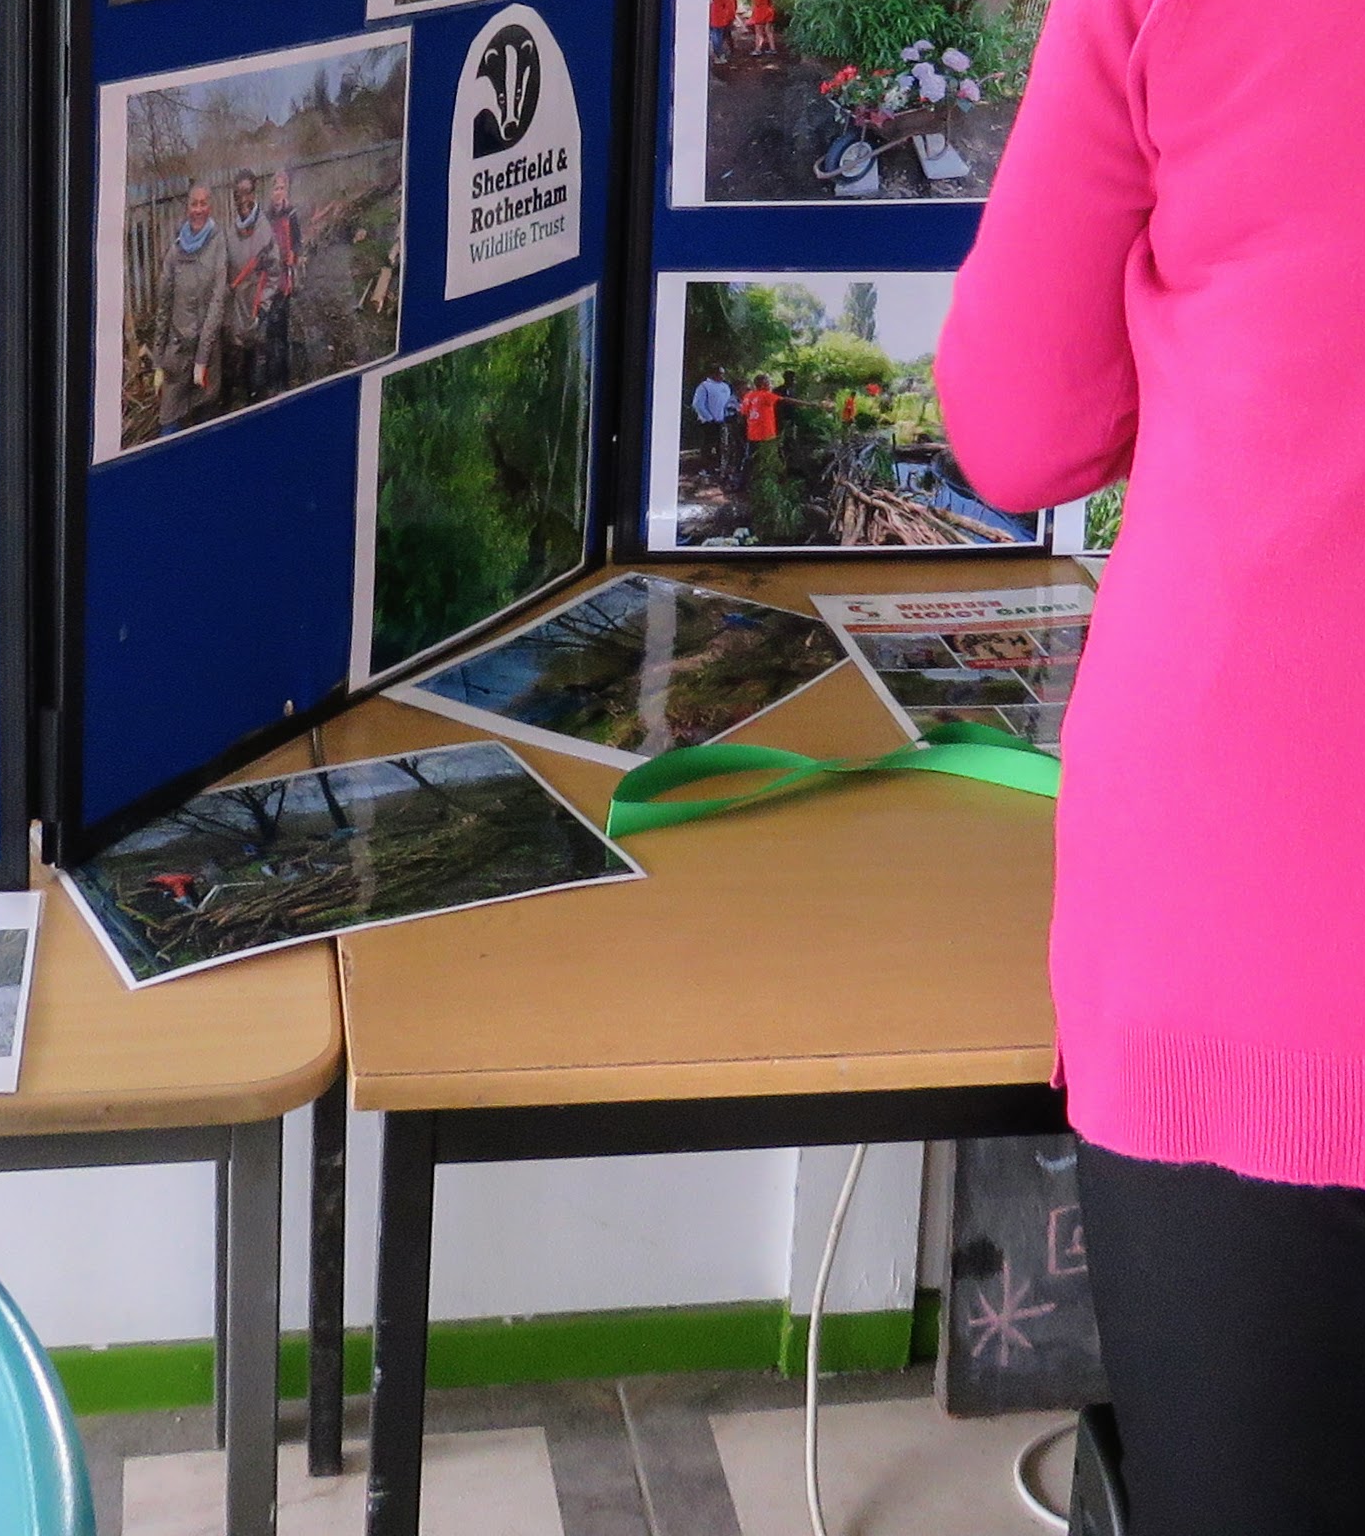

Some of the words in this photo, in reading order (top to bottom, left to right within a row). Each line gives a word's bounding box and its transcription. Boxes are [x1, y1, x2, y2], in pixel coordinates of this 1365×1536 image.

[472, 149, 554, 199] Sheffield
[557, 147, 568, 172] &
[470, 184, 568, 235] Rotherham
[470, 227, 527, 264] Wildlife
[530, 214, 565, 243] Trust
[895, 600, 1003, 611] WINDRUSH
[901, 609, 987, 620] LEGACY
[995, 603, 1080, 616] GARDEN
